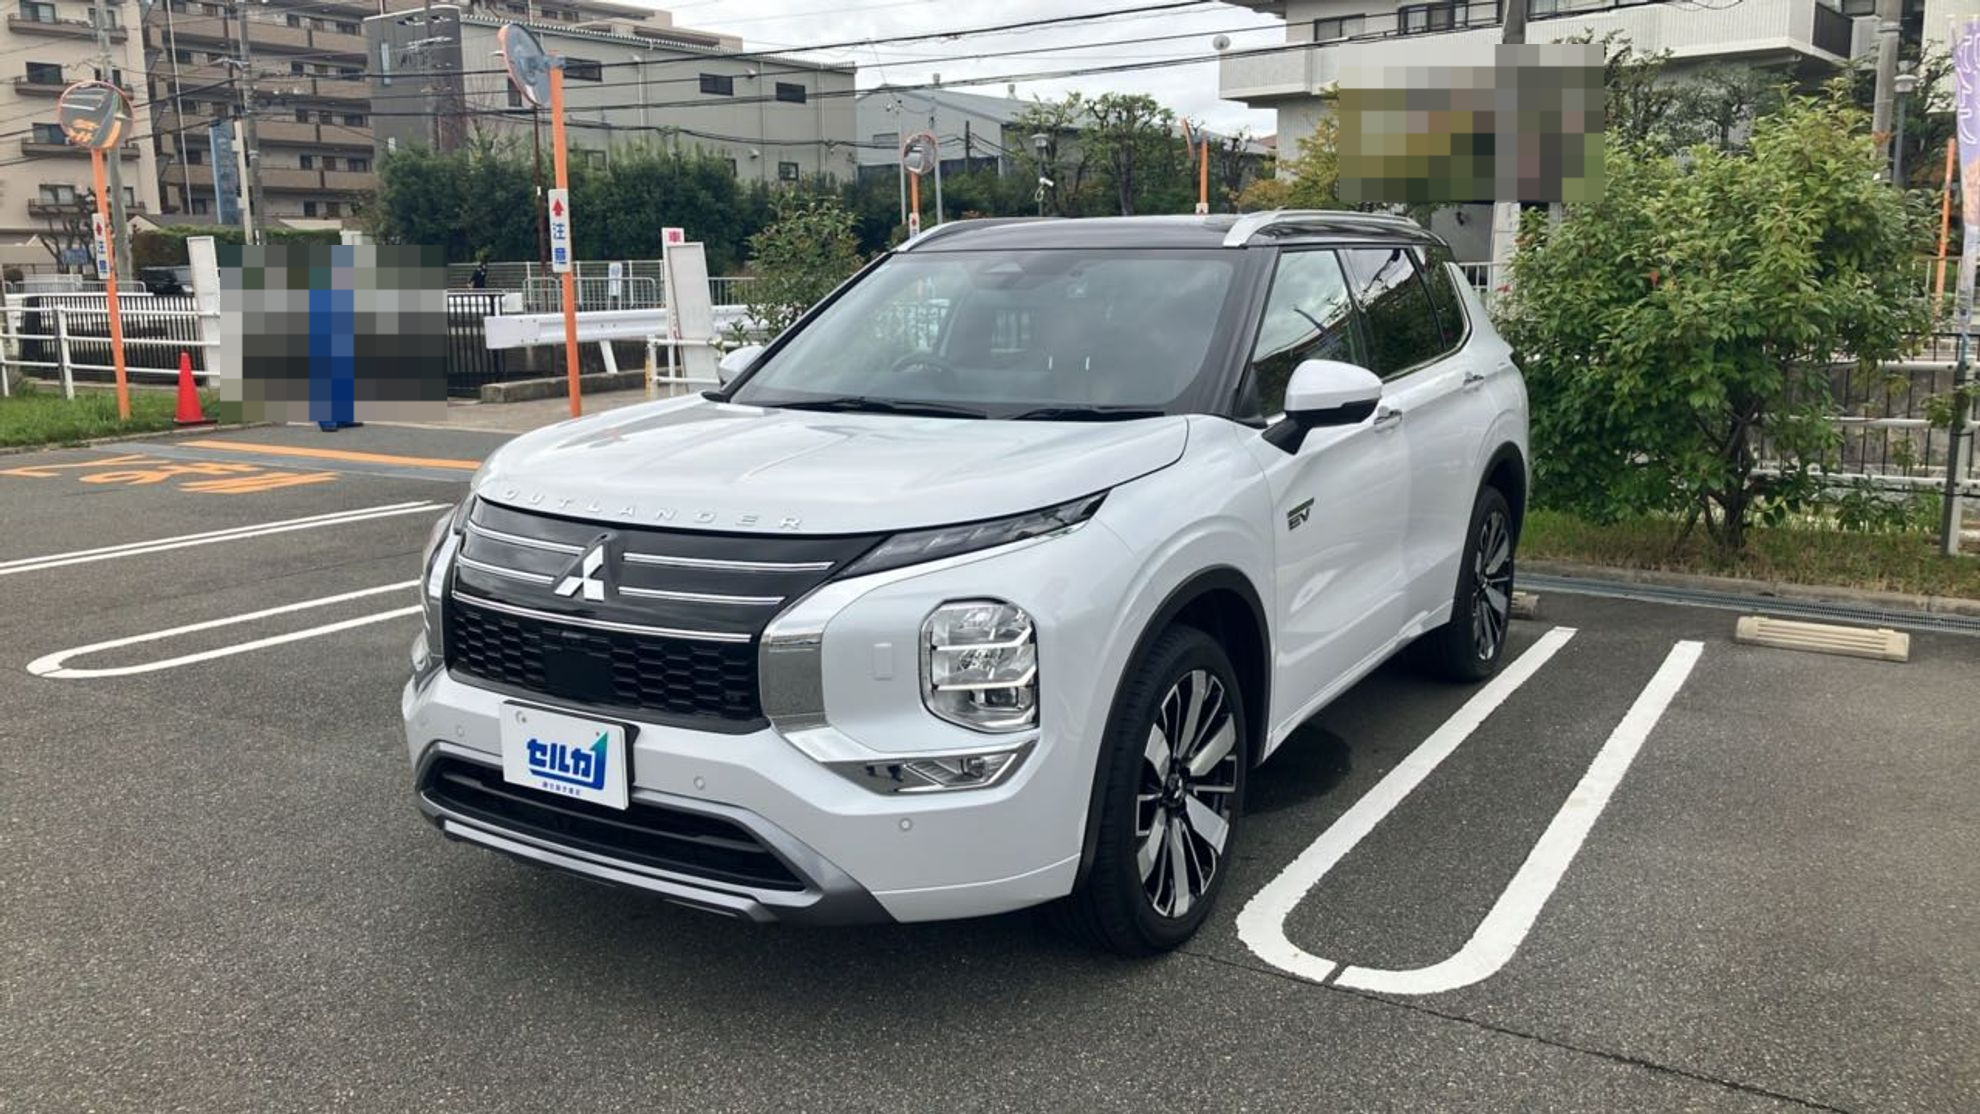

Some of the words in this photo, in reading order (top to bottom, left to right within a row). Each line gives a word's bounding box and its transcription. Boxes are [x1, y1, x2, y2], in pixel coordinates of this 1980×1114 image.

[505, 488, 802, 530] OUTLANDER
[526, 738, 593, 779] セルカ
